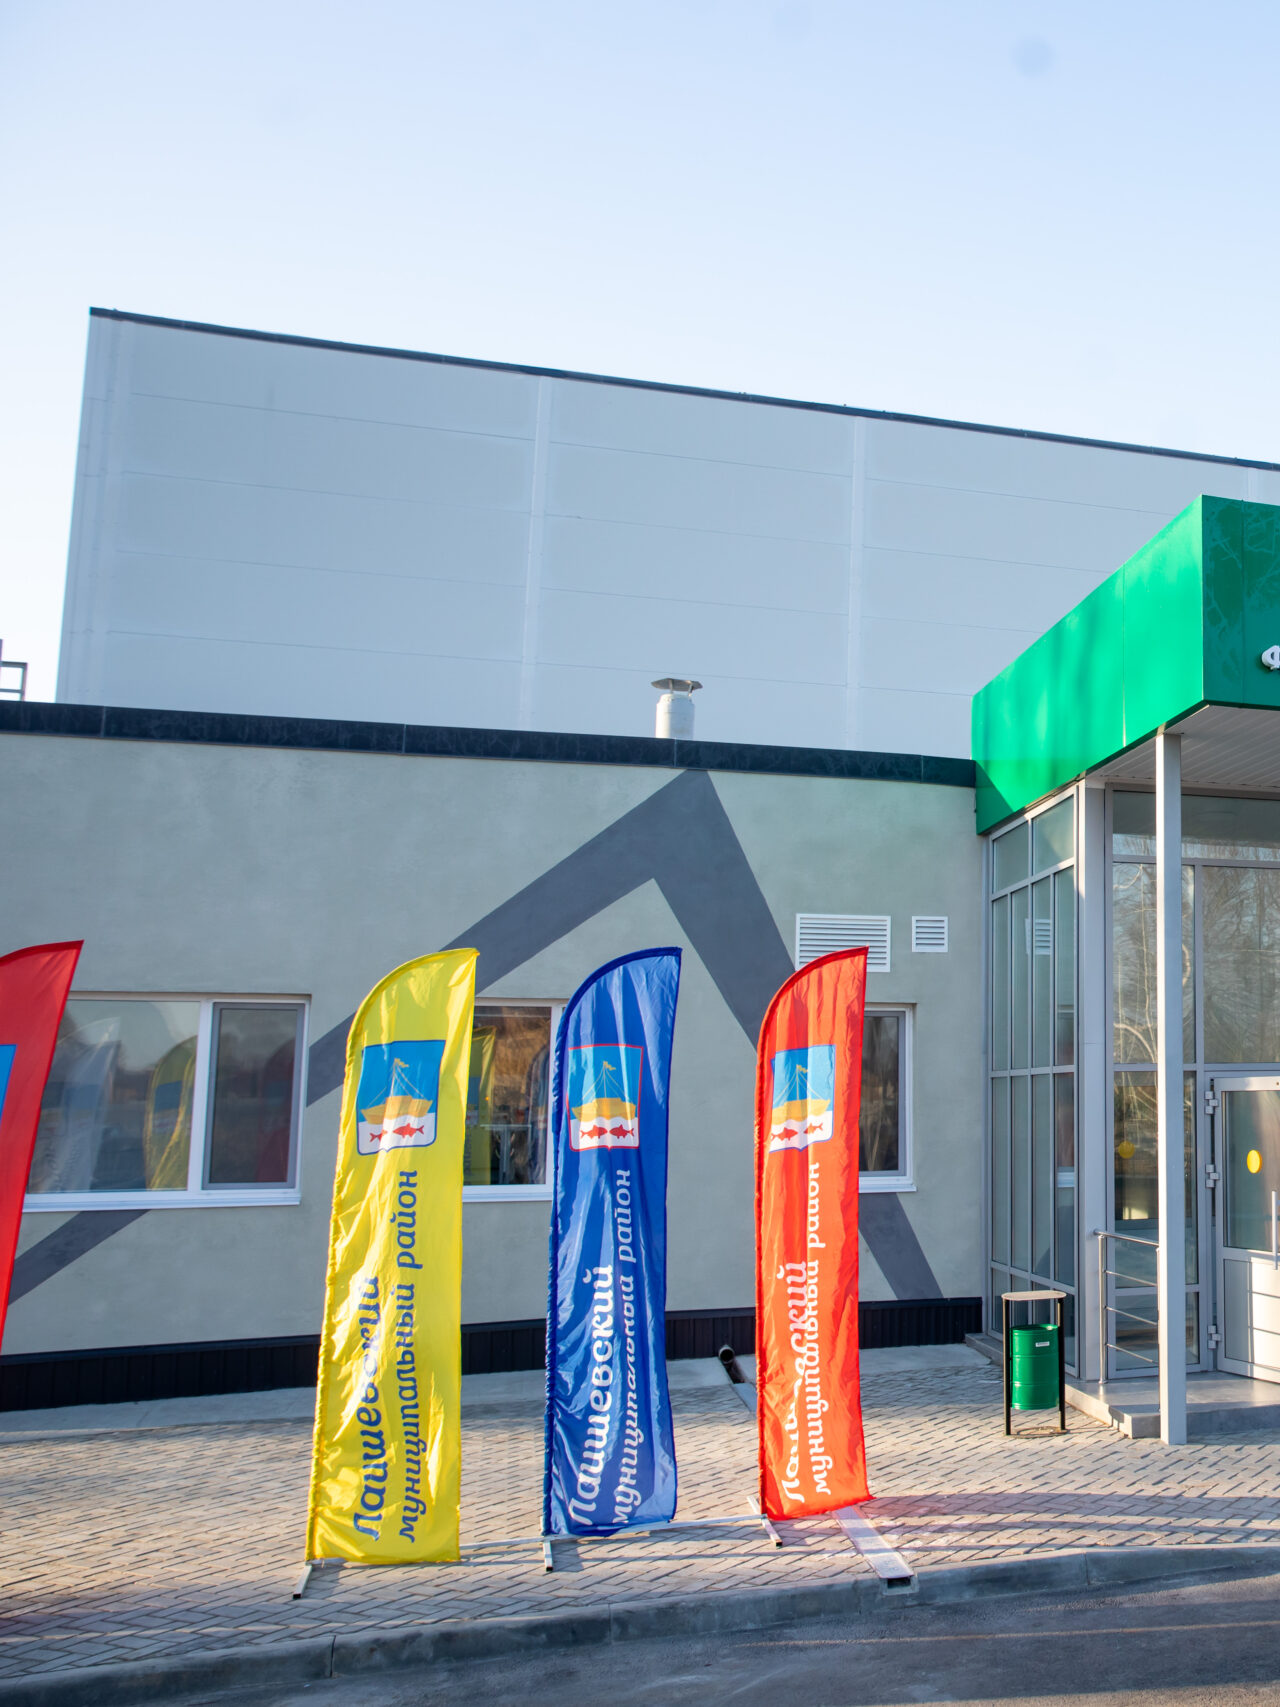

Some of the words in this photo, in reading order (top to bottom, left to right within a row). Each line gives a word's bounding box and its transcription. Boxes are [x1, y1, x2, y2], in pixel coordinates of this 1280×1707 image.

[390, 1170, 424, 1269] район
[614, 1169, 637, 1264] район
[807, 1162, 826, 1249] район
[390, 1283, 427, 1543] муниципальный
[568, 1264, 614, 1526] Лаишевский
[804, 1259, 833, 1496] муниципальный
